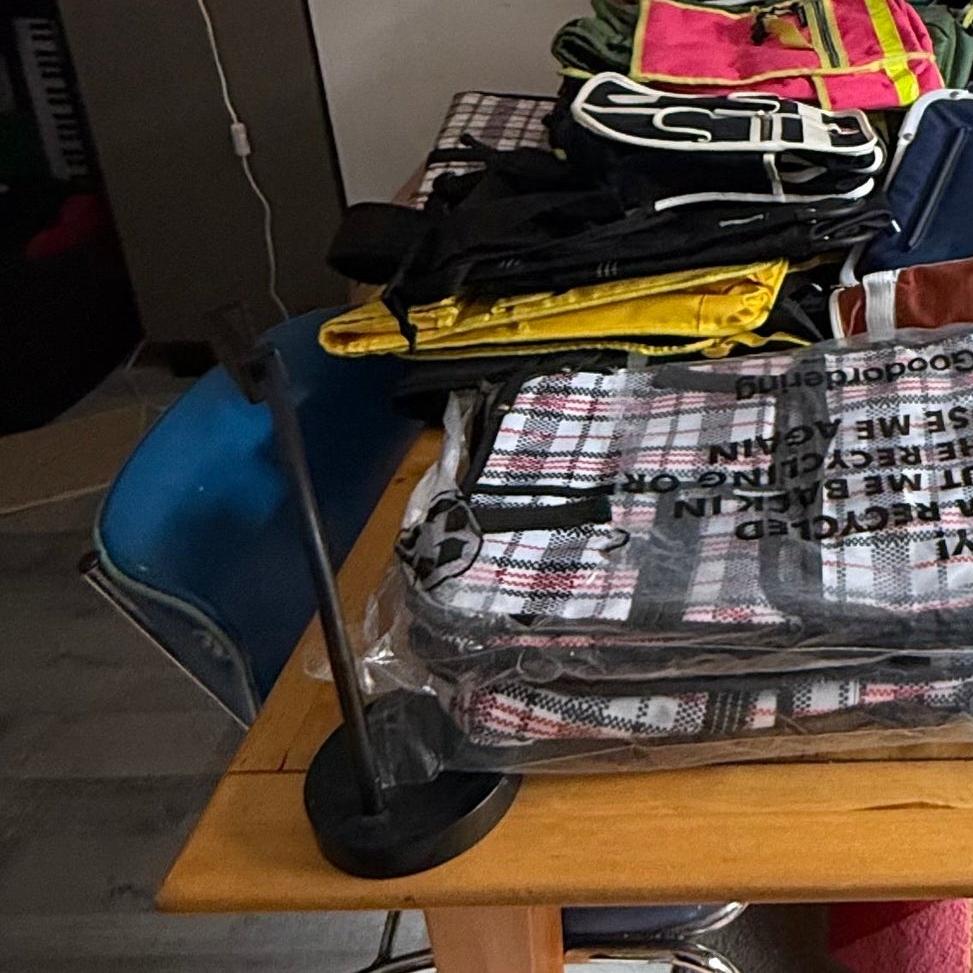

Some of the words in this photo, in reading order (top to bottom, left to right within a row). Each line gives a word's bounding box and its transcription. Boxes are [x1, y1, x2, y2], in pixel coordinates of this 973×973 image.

[709, 418, 841, 464] AGAIN
[856, 414, 910, 440] ME
[700, 445, 922, 490] RECYCLING
[623, 473, 681, 493] OR
[736, 477, 849, 509] BACK
[864, 472, 922, 495] ME
[673, 494, 722, 518] IN
[735, 500, 941, 540] RECYCLED
